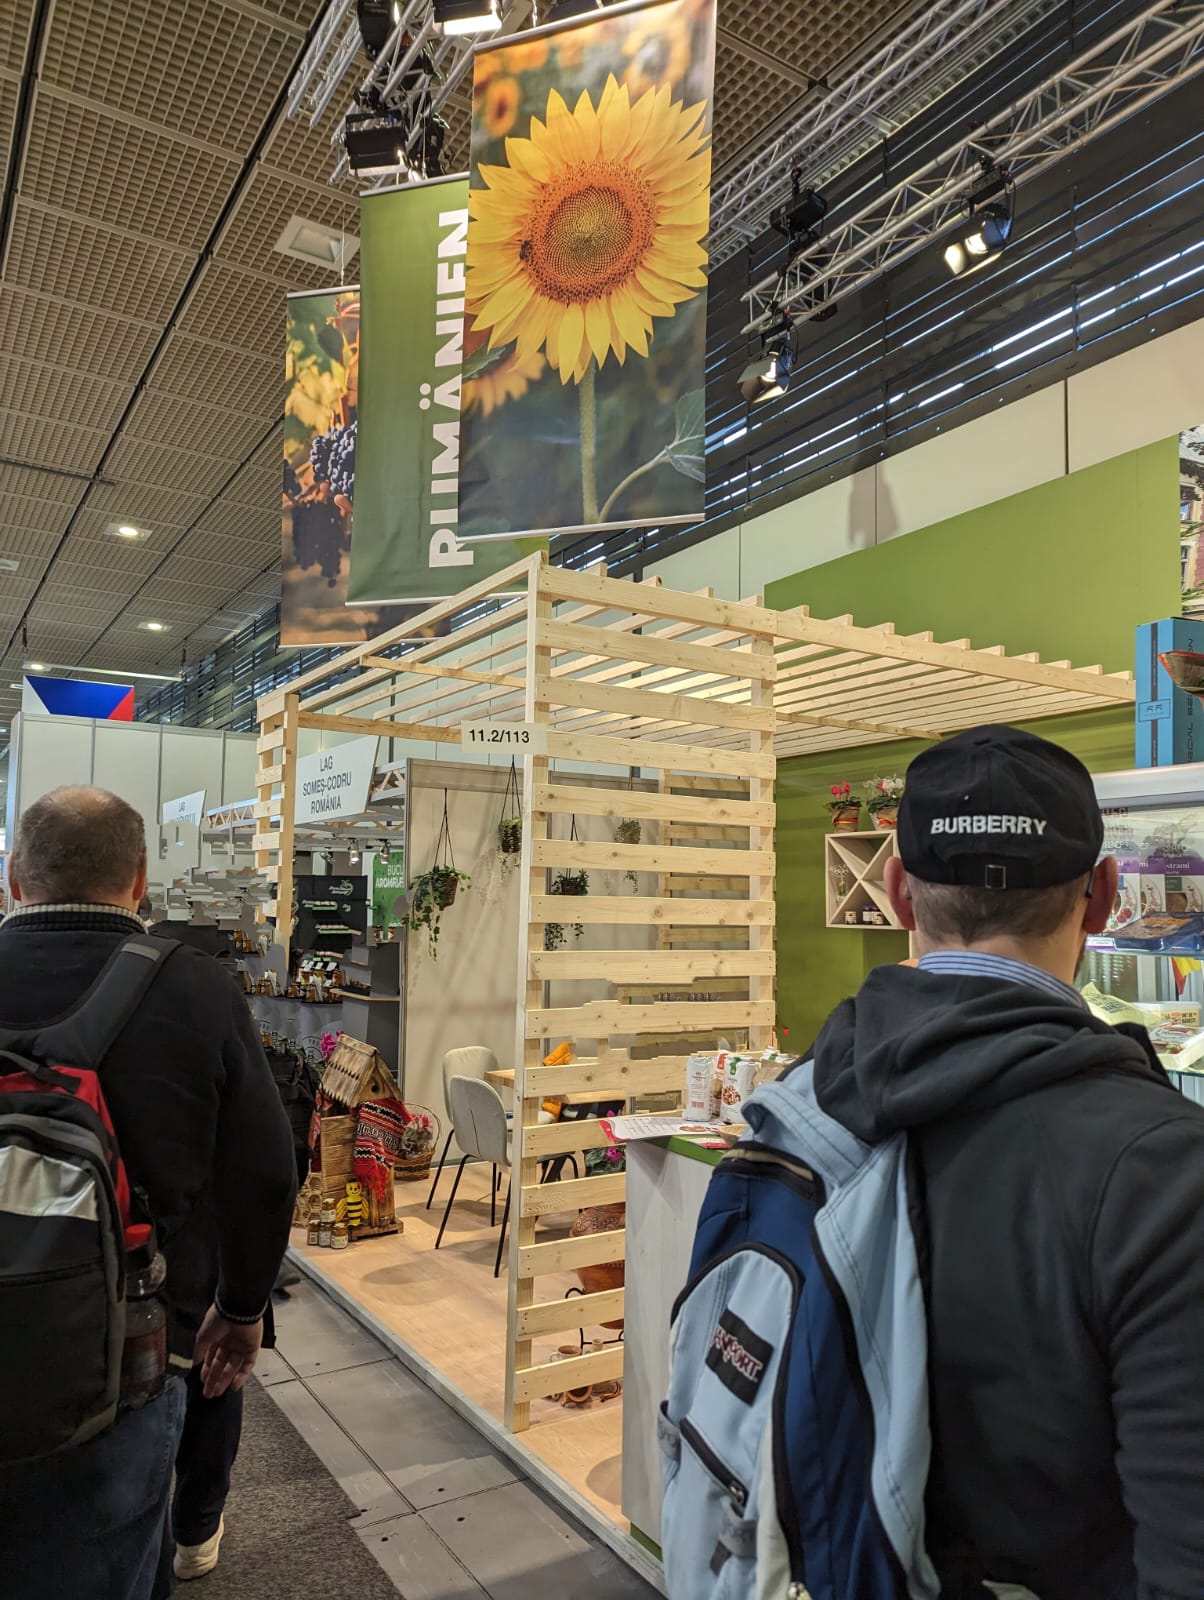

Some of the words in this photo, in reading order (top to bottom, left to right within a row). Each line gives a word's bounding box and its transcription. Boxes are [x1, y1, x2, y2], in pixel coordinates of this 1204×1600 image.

[469, 729, 530, 743] 11.2/113
[320, 755, 334, 772] LAG
[310, 795, 342, 814] ROMÂNIA
[930, 815, 1047, 836] BURBERRY
